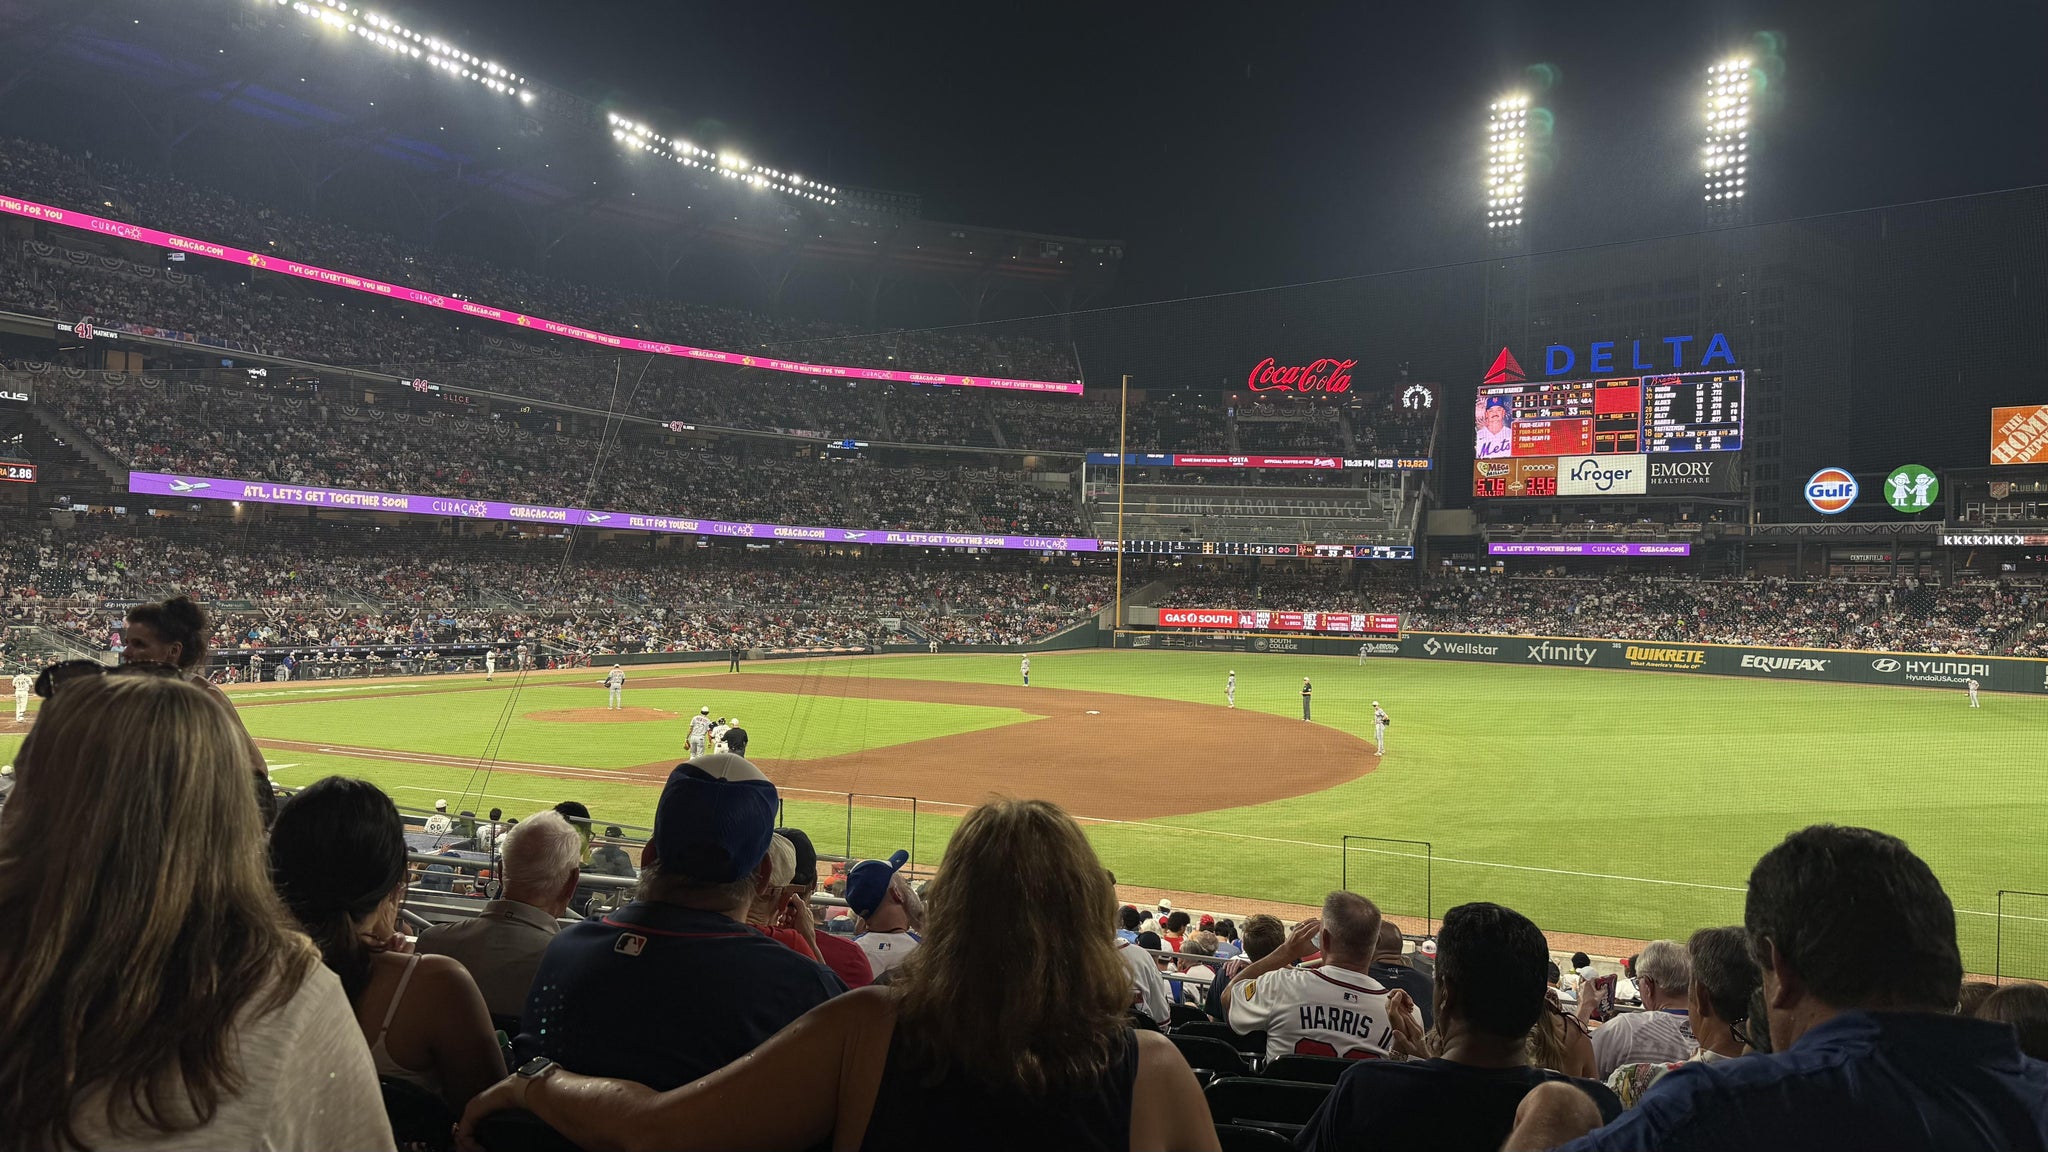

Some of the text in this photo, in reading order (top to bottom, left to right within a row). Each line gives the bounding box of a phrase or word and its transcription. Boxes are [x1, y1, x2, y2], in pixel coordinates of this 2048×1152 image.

[24, 205, 41, 215] FOR
[44, 209, 63, 220] YOU
[169, 238, 224, 256] CURAÇAO.COM
[289, 265, 391, 293] I'VE GOT EVERYTHING YOU NEED
[74, 322, 93, 339] 41
[93, 330, 118, 339] MATHEWS
[1546, 333, 1736, 376] DELTA
[413, 378, 428, 392] 44
[444, 393, 470, 404] SLICE
[1569, 408, 1578, 416] 33
[670, 421, 684, 432] 47
[1999, 413, 2027, 436] THE
[1479, 439, 1511, 458] Mets
[10, 468, 32, 479] 2.86
[1571, 460, 1632, 491] Kroger
[1651, 461, 1714, 479] EMORY
[1477, 479, 1505, 491] 576
[1527, 478, 1556, 490] 396
[1651, 477, 1711, 485] HEALTHCARE
[244, 485, 408, 509] ATL, LET'S GET TOGETHER SOON
[1809, 484, 1853, 498] Gulf
[510, 507, 566, 521] CURAÇAO.COM
[1173, 498, 1367, 517] HANK AARON TERRACE
[630, 517, 699, 531] FEEL IT FOR YOURSELF
[906, 534, 927, 543] LET'S
[929, 535, 944, 544] GET
[985, 538, 1005, 546] SOON
[1165, 614, 1233, 624] GAS SOUTH
[1240, 616, 1254, 625] AL
[1444, 642, 1499, 656] Wellstar
[1528, 641, 1597, 665] xfinity
[1625, 646, 1706, 664] QUIKRETE
[1741, 654, 1826, 673] EQUIFAX
[1906, 661, 1990, 677] HYUNDAI
[1300, 1006, 1373, 1039] HARRIS
